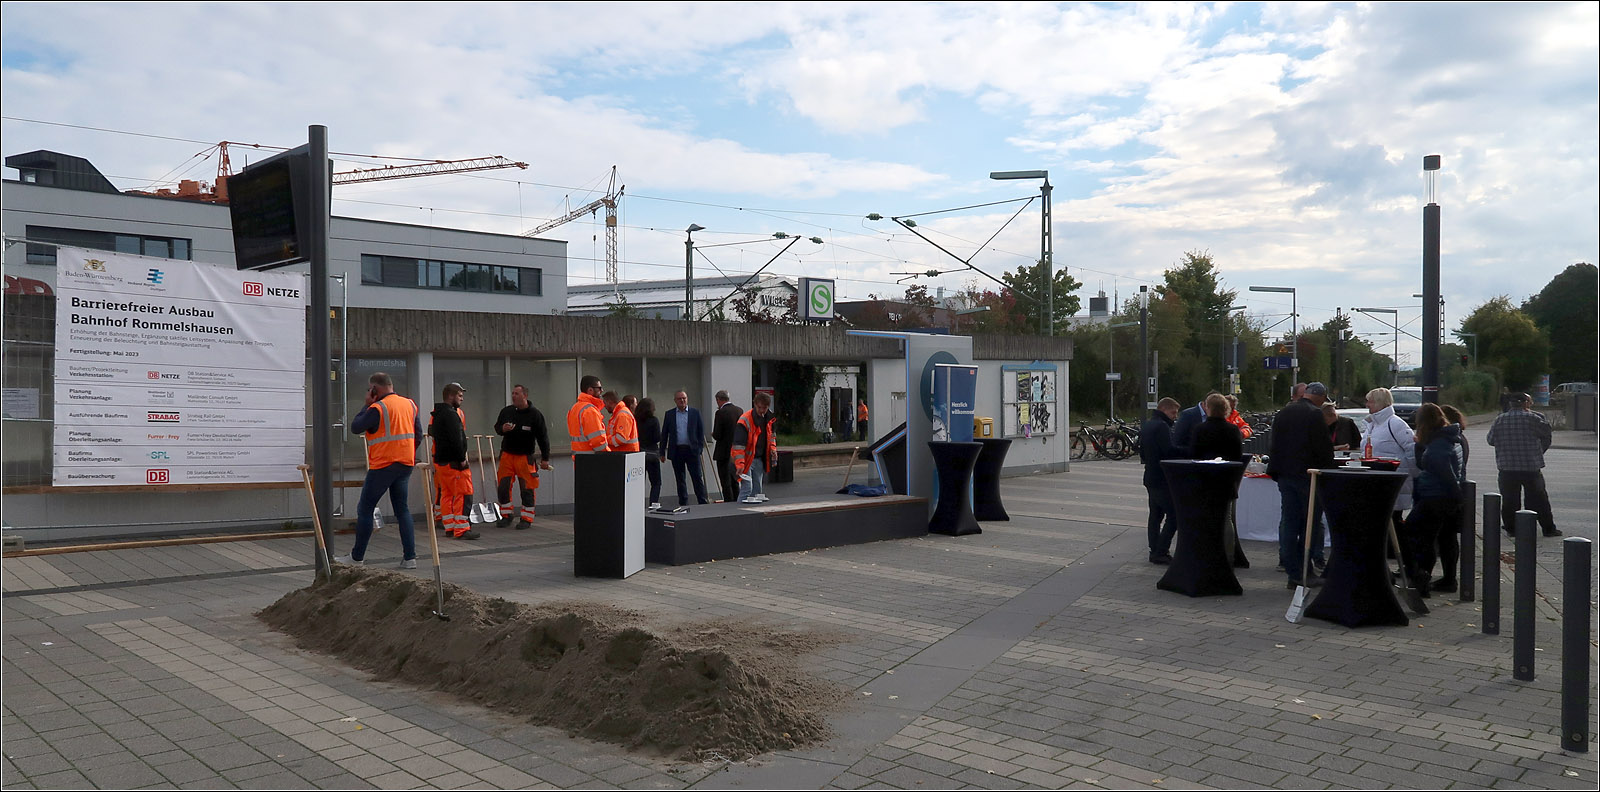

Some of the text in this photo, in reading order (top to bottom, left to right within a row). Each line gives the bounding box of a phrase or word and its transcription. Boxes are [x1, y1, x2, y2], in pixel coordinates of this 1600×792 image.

[245, 283, 300, 298] DB NETZE
[71, 297, 215, 318] Barrierefreier Ausbau
[71, 314, 234, 335] Bahnhof Rommelshausen
[69, 348, 112, 356] Fertigstellung:
[1264, 358, 1270, 367] 1
[1149, 378, 1156, 393] H
[150, 451, 170, 460] SPL
[149, 471, 167, 482] DB
